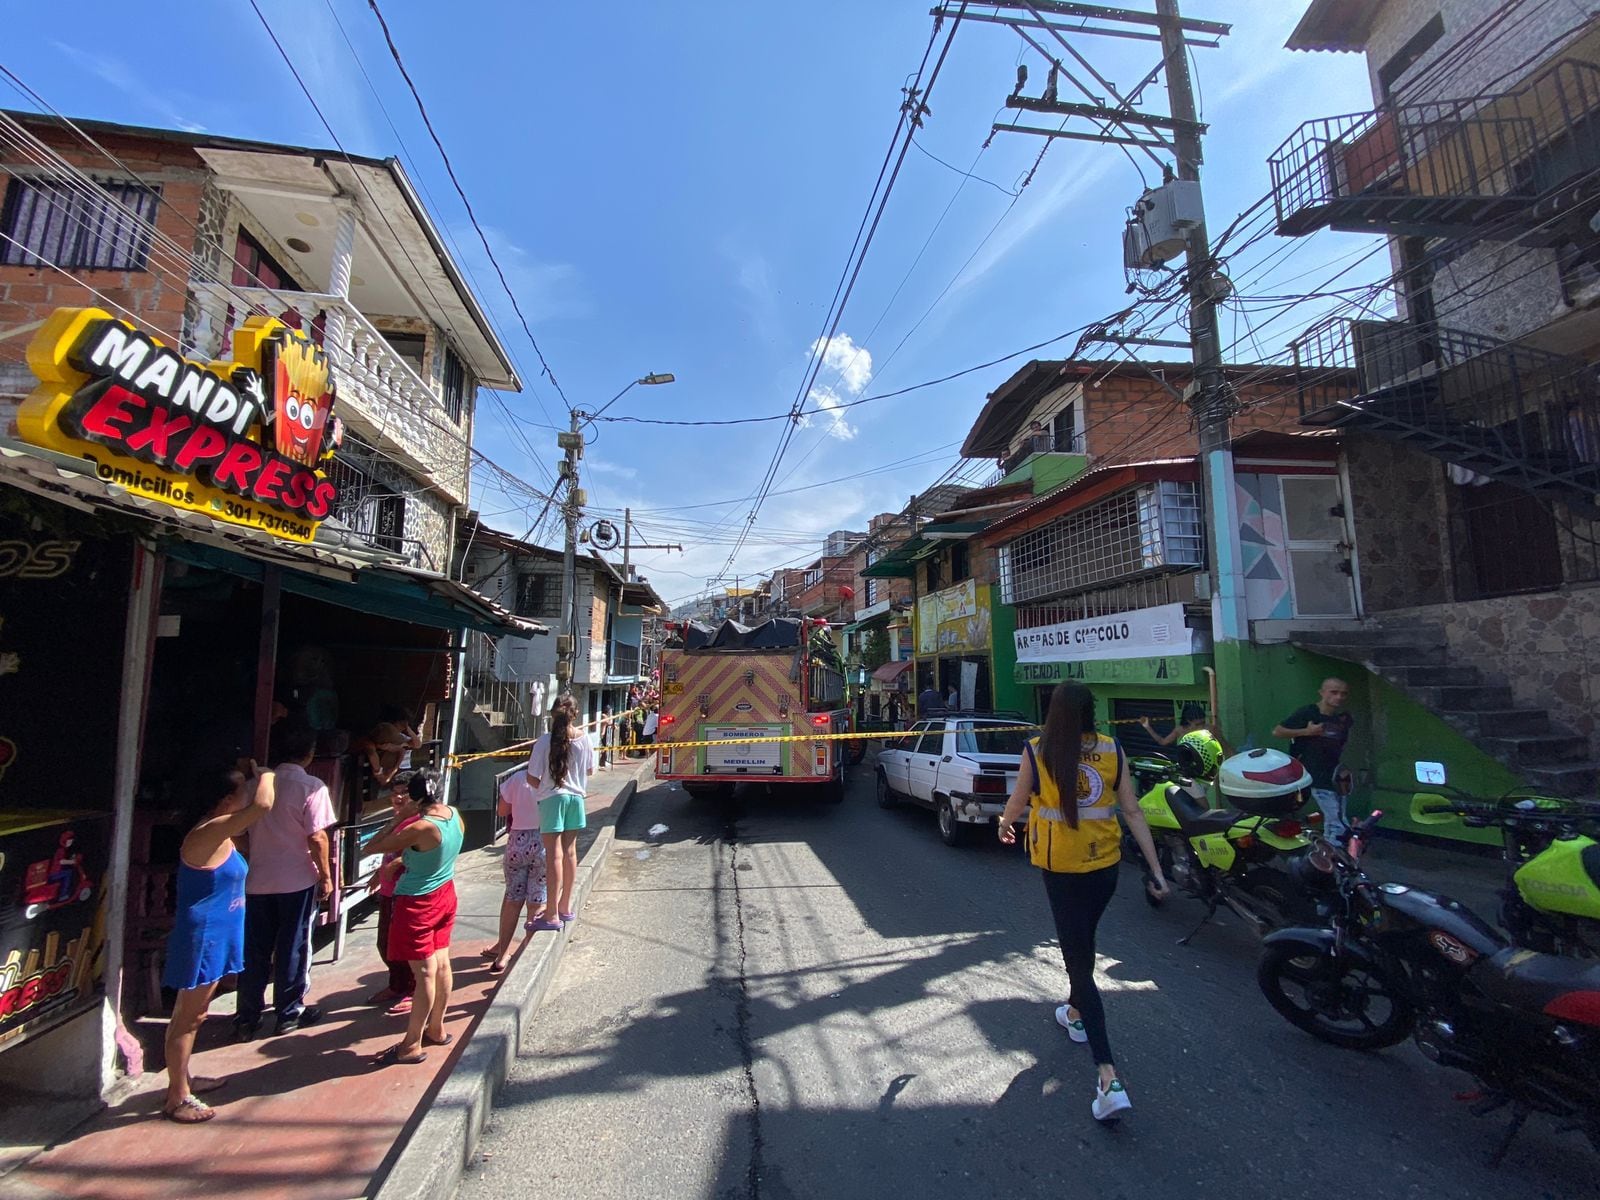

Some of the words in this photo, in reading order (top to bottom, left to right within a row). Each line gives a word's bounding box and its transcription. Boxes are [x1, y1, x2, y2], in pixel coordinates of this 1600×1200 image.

[91, 327, 253, 435] MANDI
[81, 385, 336, 518] EXPRESS
[82, 453, 195, 505] omicilios
[224, 500, 252, 522] 301
[257, 510, 312, 540] 7376540
[1057, 630, 1070, 645] DE
